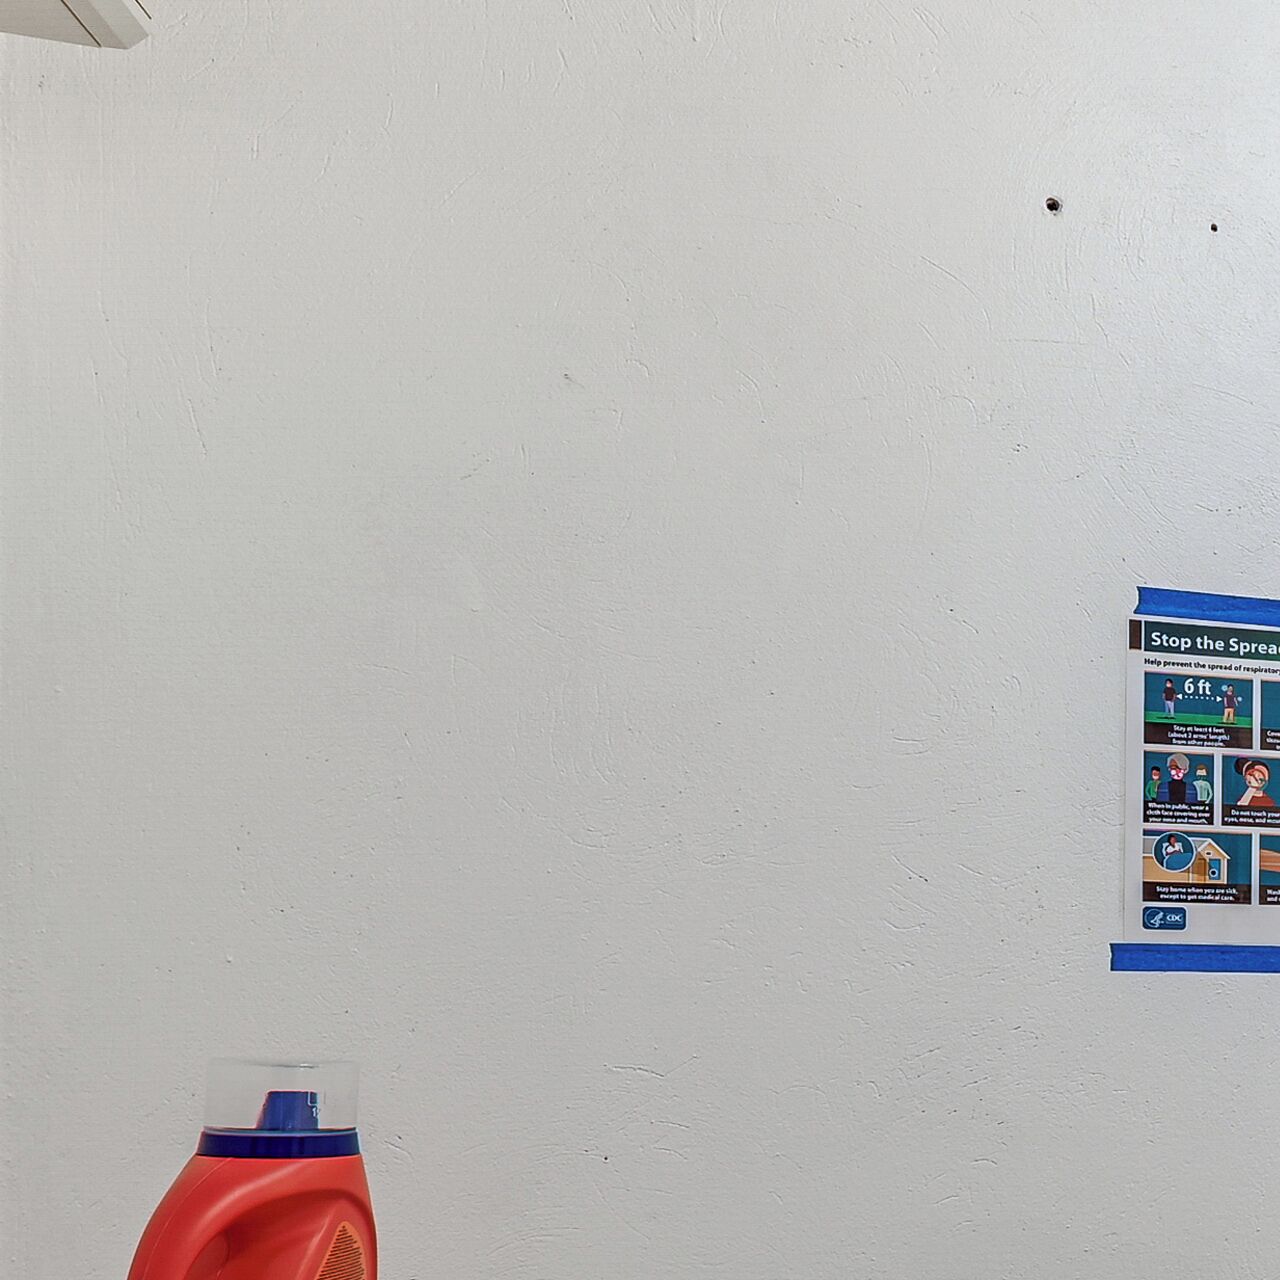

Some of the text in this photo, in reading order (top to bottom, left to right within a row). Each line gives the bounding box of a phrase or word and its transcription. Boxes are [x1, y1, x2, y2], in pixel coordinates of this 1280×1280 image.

[1151, 632, 1192, 651] Stop
[1197, 635, 1224, 651] the
[1144, 658, 1162, 667] Help
[1163, 660, 1192, 668] prevent
[1194, 661, 1206, 669] the
[1208, 663, 1232, 671] spread
[1184, 678, 1211, 695] 6 ft
